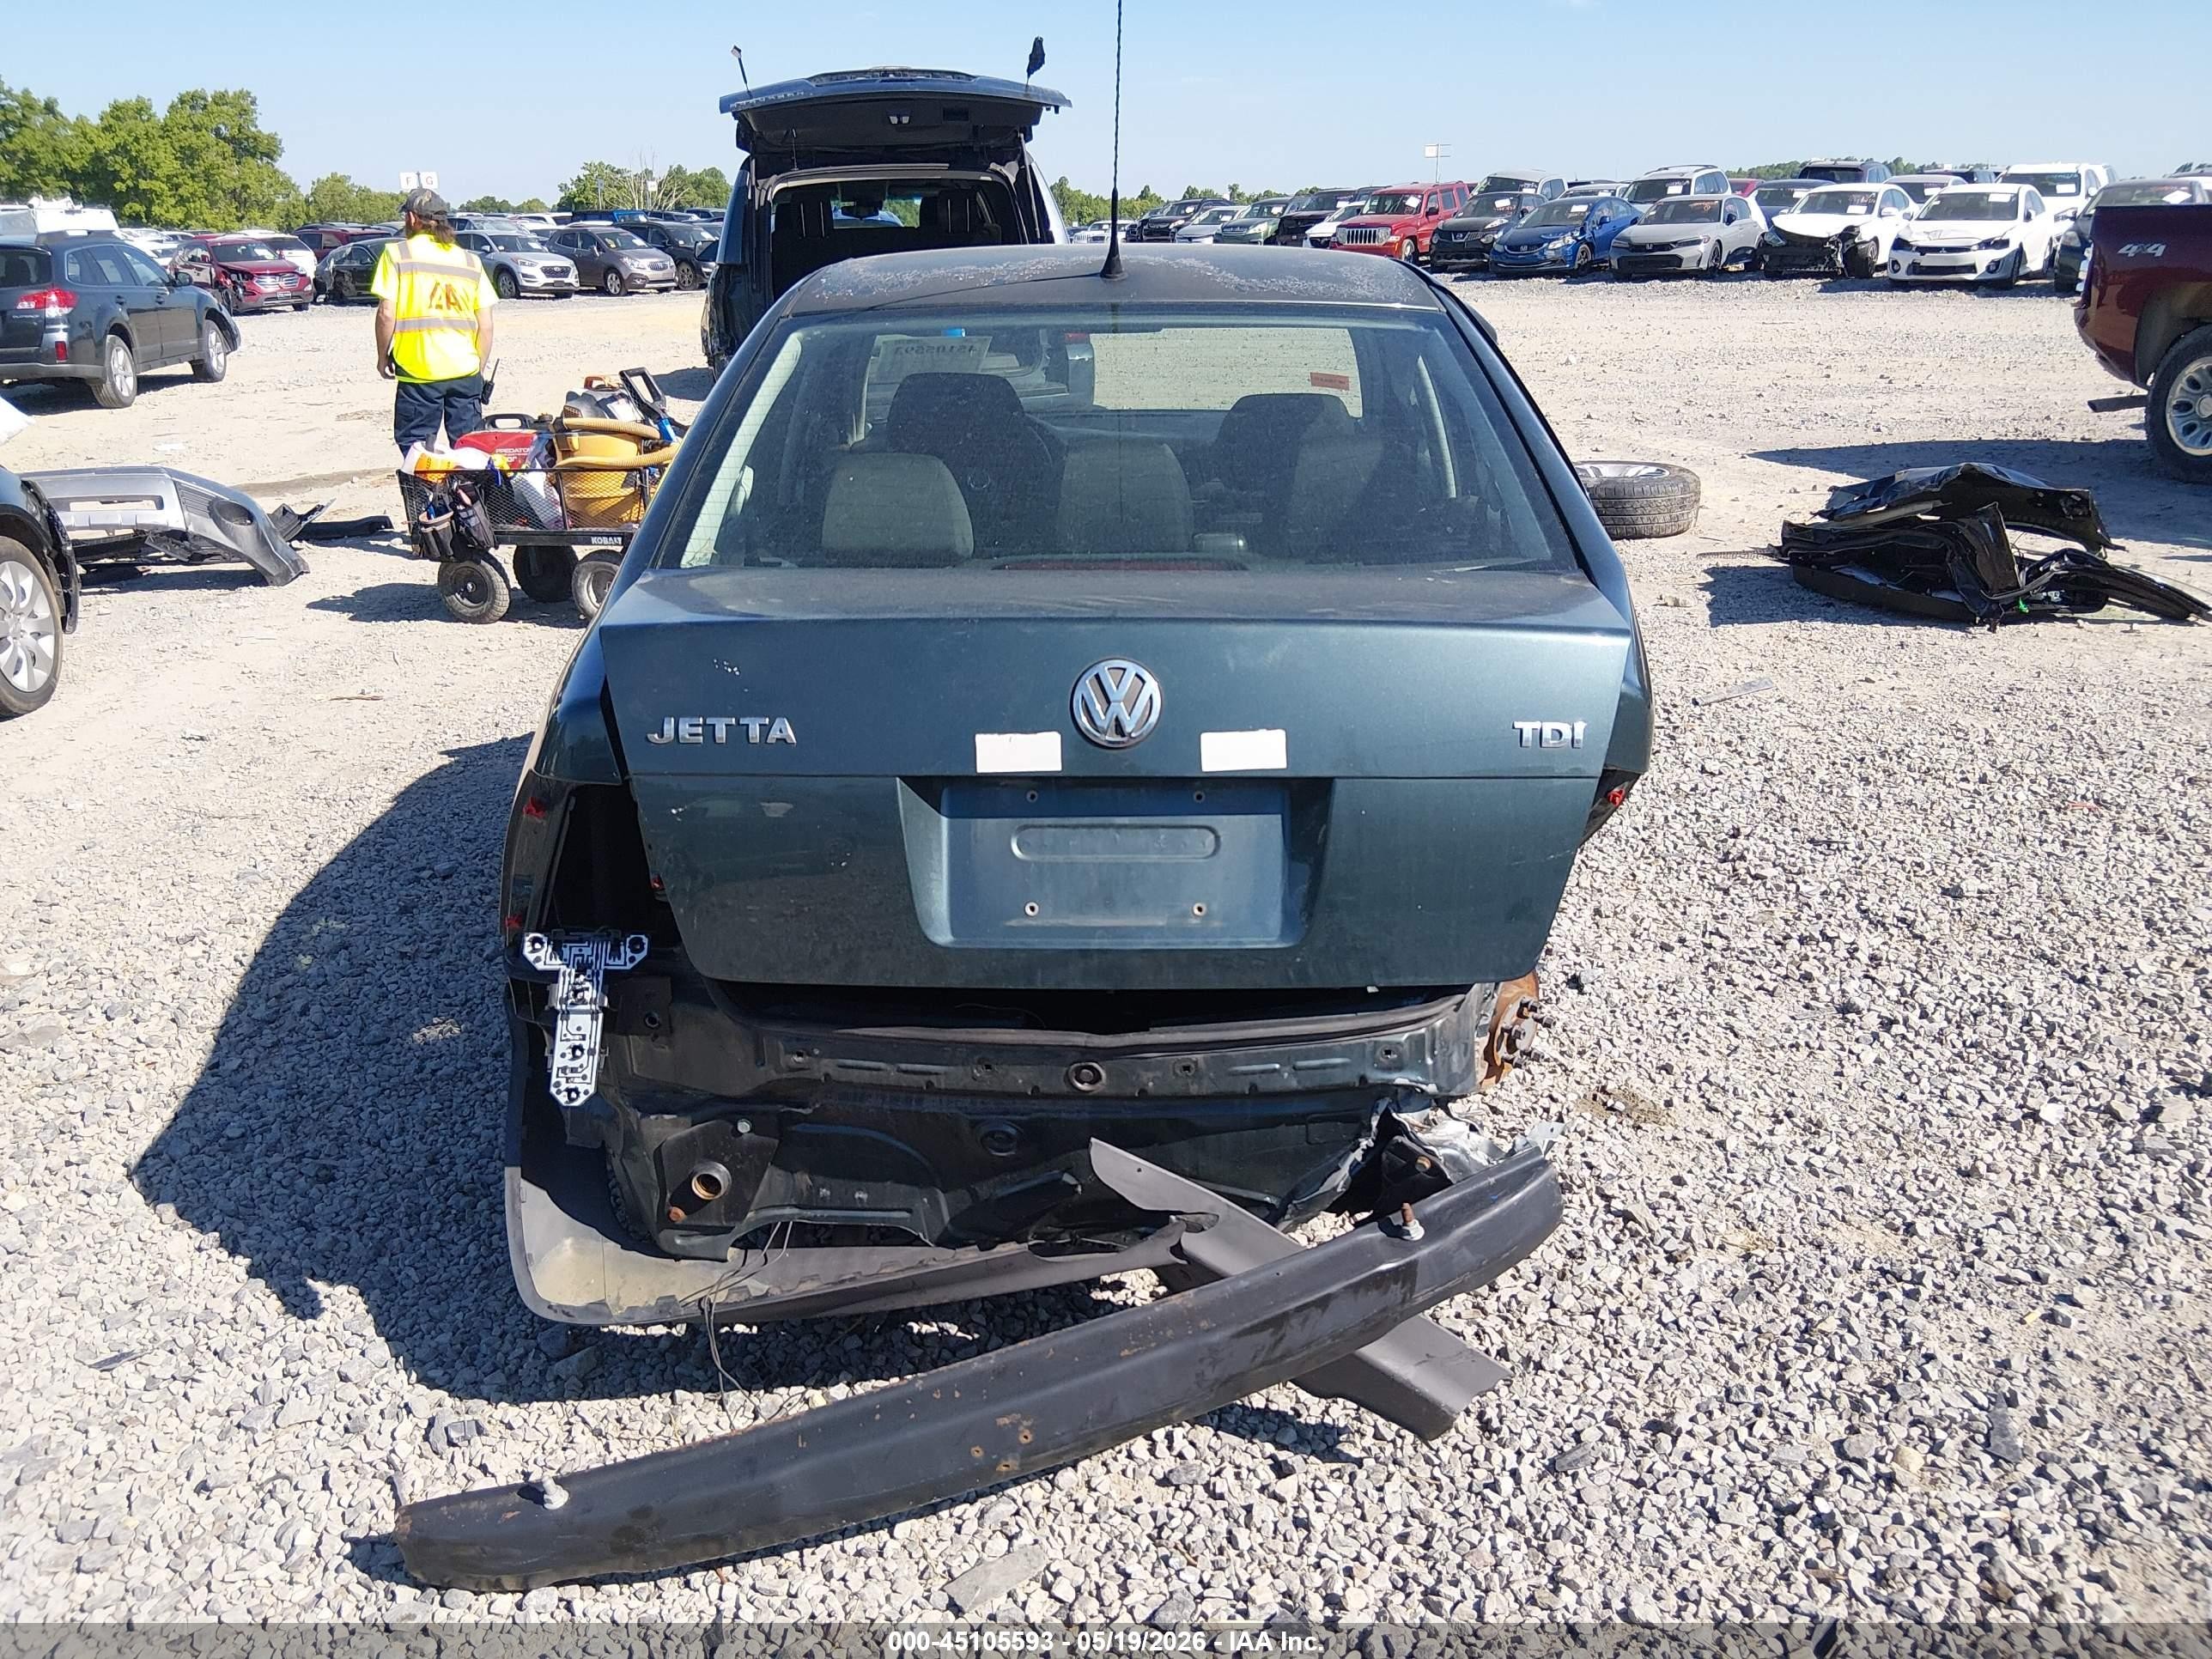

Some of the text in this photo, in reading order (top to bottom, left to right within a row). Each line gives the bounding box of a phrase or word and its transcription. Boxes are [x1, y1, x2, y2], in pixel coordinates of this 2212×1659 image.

[425, 175, 433, 185] G
[591, 536, 623, 545] KOBALT
[1074, 660, 1159, 746] VW
[646, 717, 797, 744] JETTA
[1512, 720, 1587, 749] TDI
